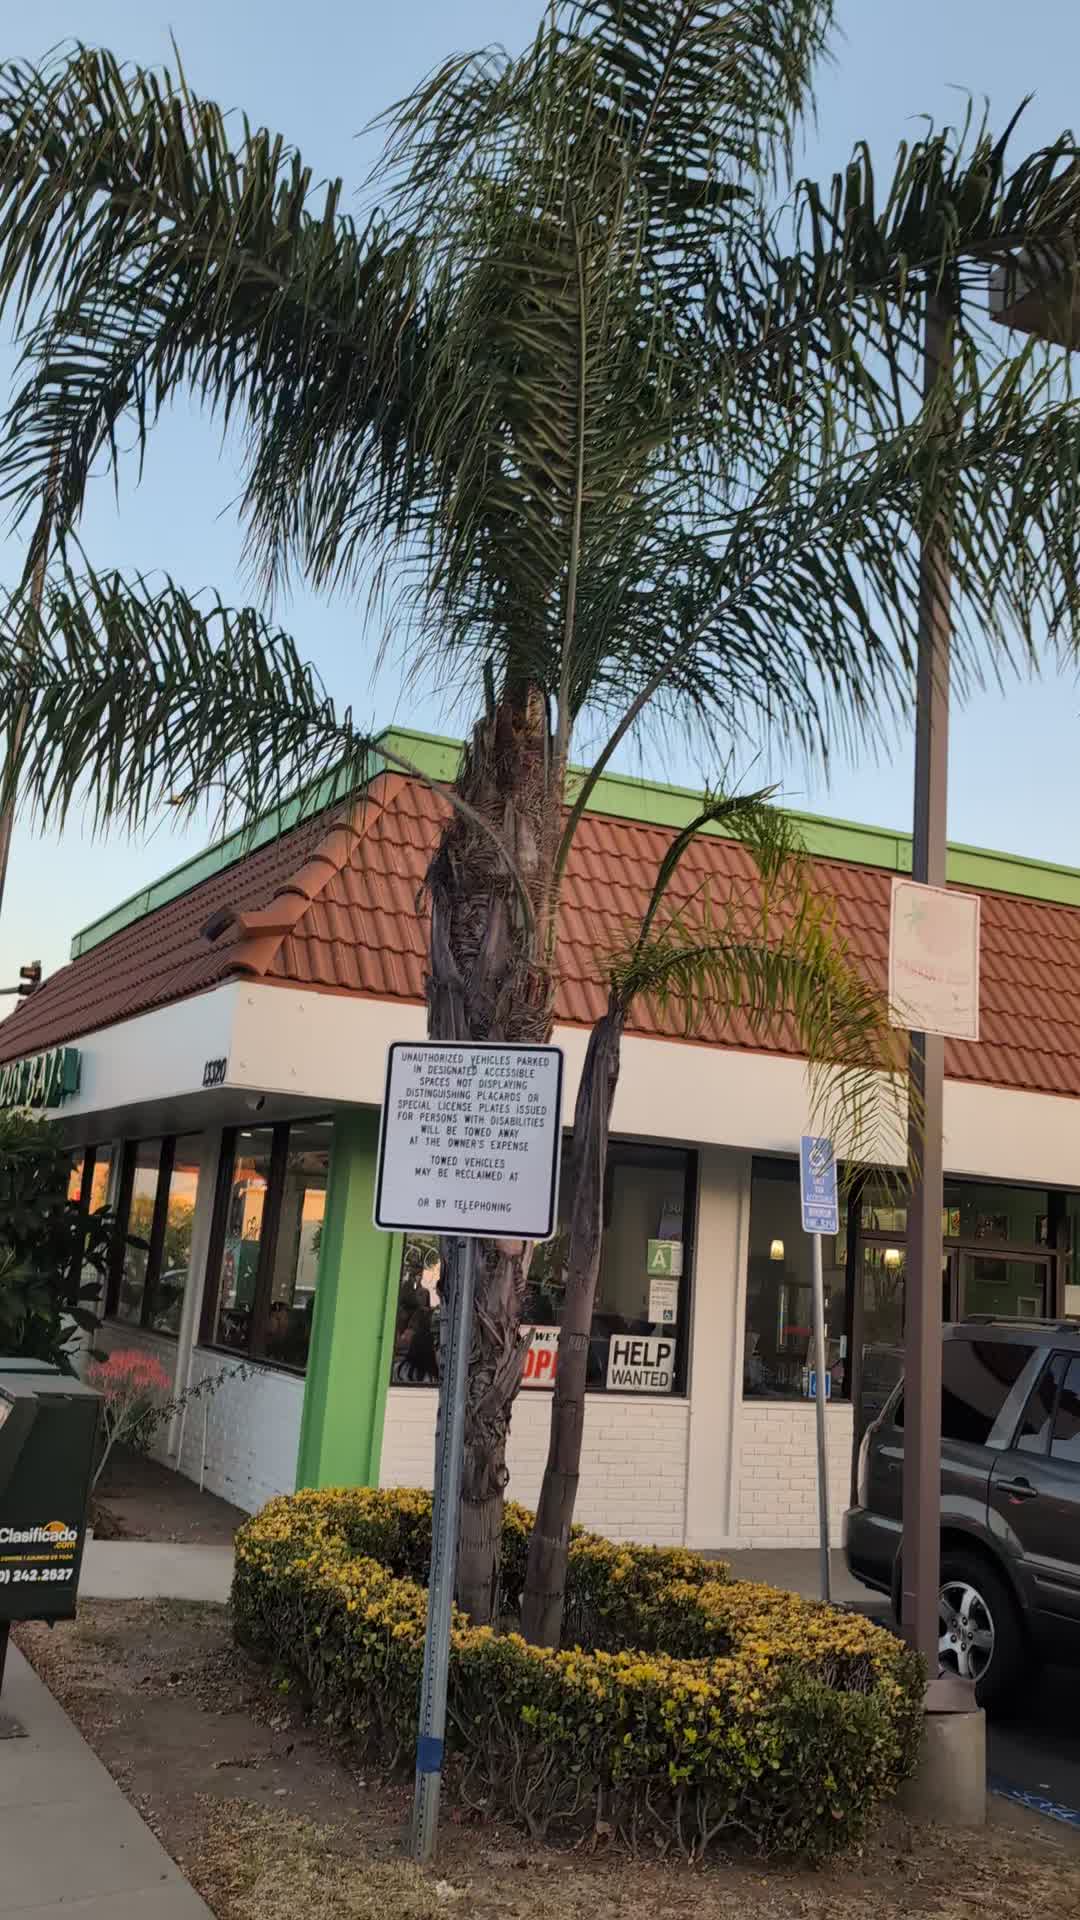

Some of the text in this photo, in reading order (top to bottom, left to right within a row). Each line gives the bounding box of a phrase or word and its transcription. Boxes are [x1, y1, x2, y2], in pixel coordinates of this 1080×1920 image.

[401, 1053, 549, 1067] UNAUTHORIZED VEHICLES PARKED
[427, 1066, 478, 1076] DESIGNATED
[484, 1068, 535, 1078] ACCESSIBLE
[420, 1078, 528, 1090] SPACES NOT DISPLAYING
[406, 1088, 539, 1102] DISTINGUISHING PLACARDS OR
[398, 1100, 547, 1115] SPECIAL LICENSE PLATES ISSUED
[397, 1112, 545, 1127] FOR PERSONS WITH DISABILITIES
[421, 1125, 519, 1138] WILL BE TOWED AWAY
[409, 1137, 529, 1151] AT THE OWNER'S EXPENSE
[431, 1155, 505, 1168] TOWED VEHICLES
[415, 1168, 518, 1182] MAY BE RECLAIMED AT
[418, 1198, 512, 1213] OR BY TELEPHONING
[652, 1250, 667, 1267] A
[613, 1341, 671, 1367] HELP
[611, 1369, 668, 1387] WANTED
[0, 1526, 77, 1543] Clasificado
